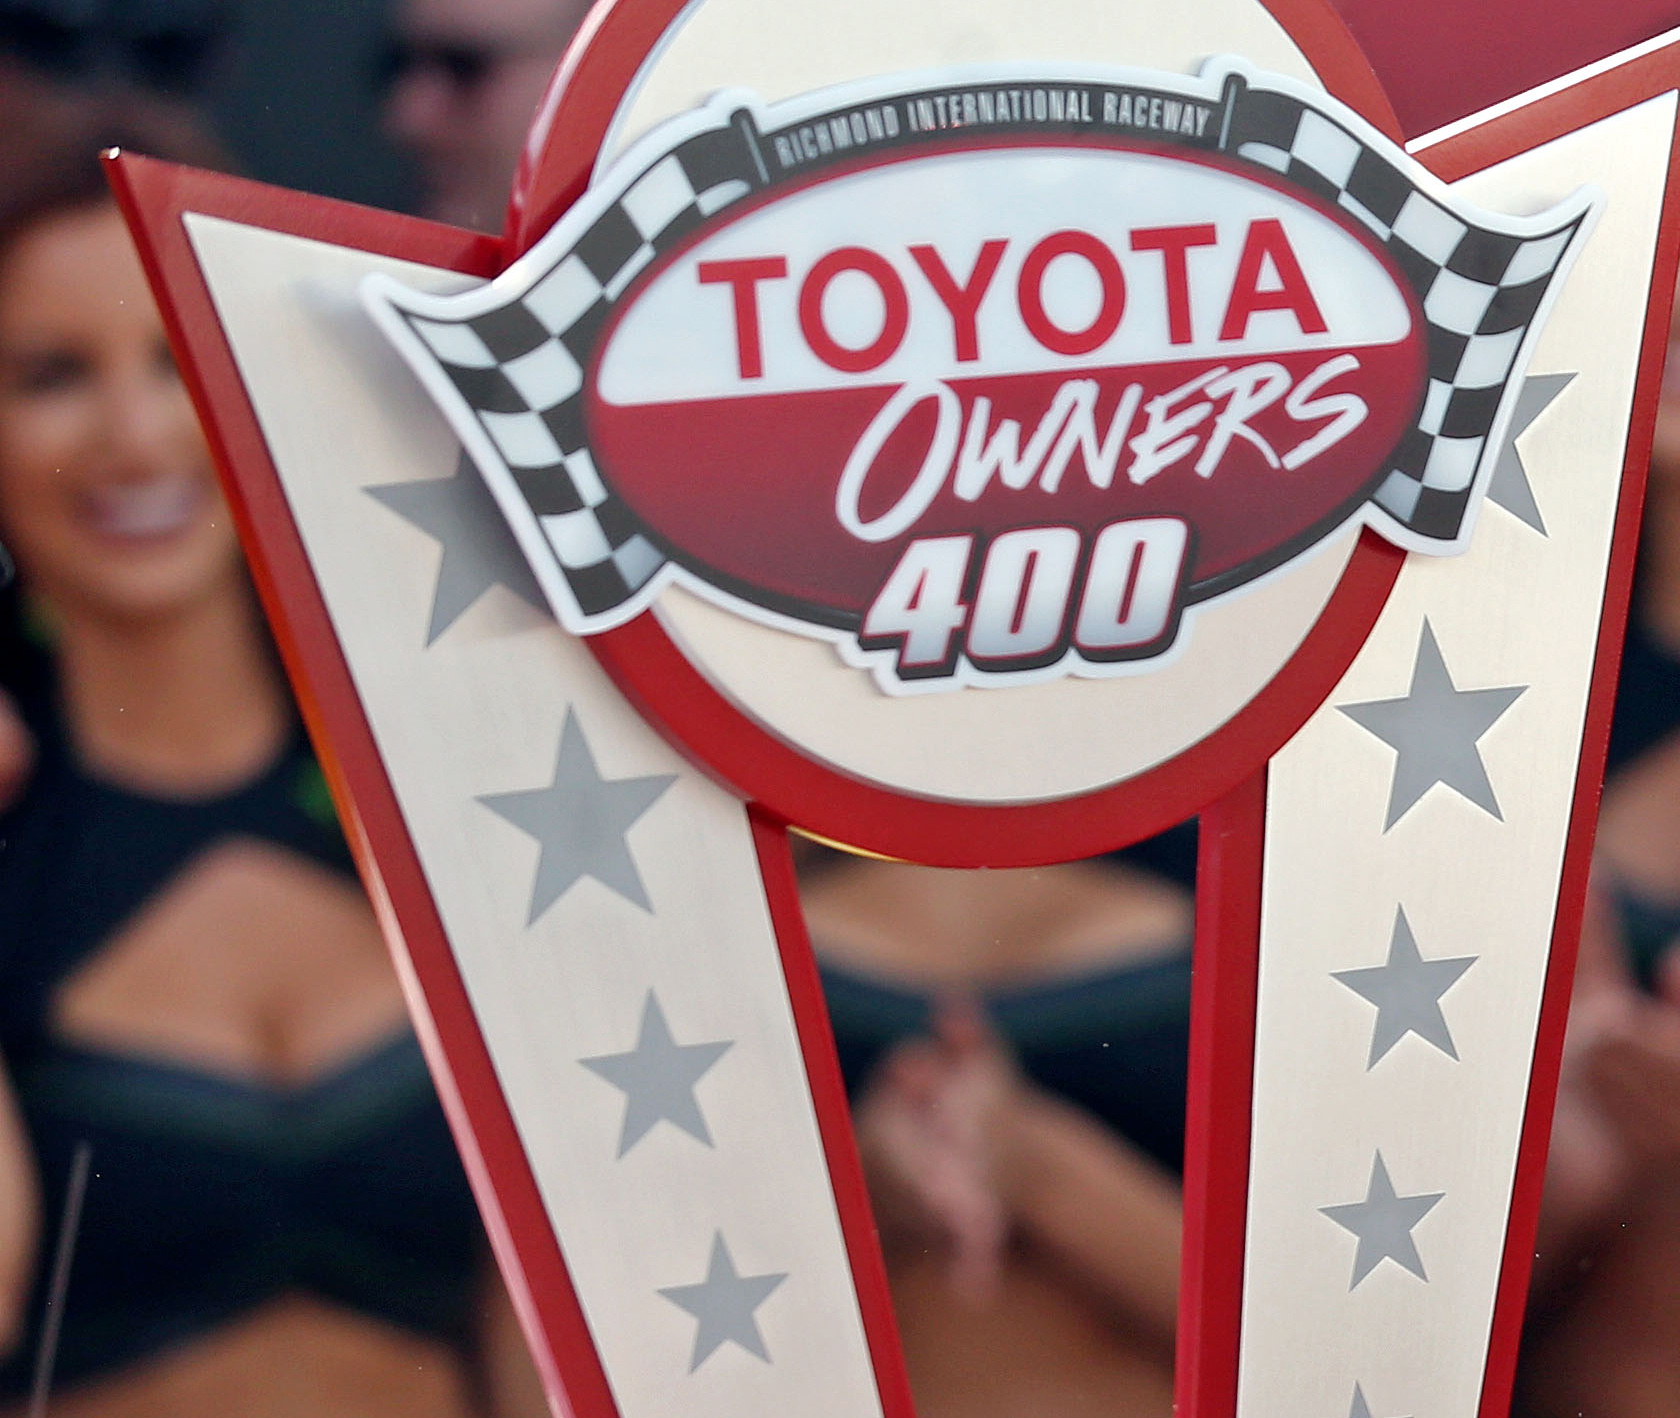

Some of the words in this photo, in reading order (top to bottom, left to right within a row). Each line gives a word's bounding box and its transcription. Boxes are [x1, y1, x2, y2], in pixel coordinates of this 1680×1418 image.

[774, 105, 900, 169] RICHMOND
[907, 89, 1093, 132] INTERNATIONAL
[1103, 91, 1212, 137] RACEWAY
[697, 217, 1329, 380] TOYOTA
[834, 352, 1369, 542] OWNERS
[862, 516, 1190, 682] 400
